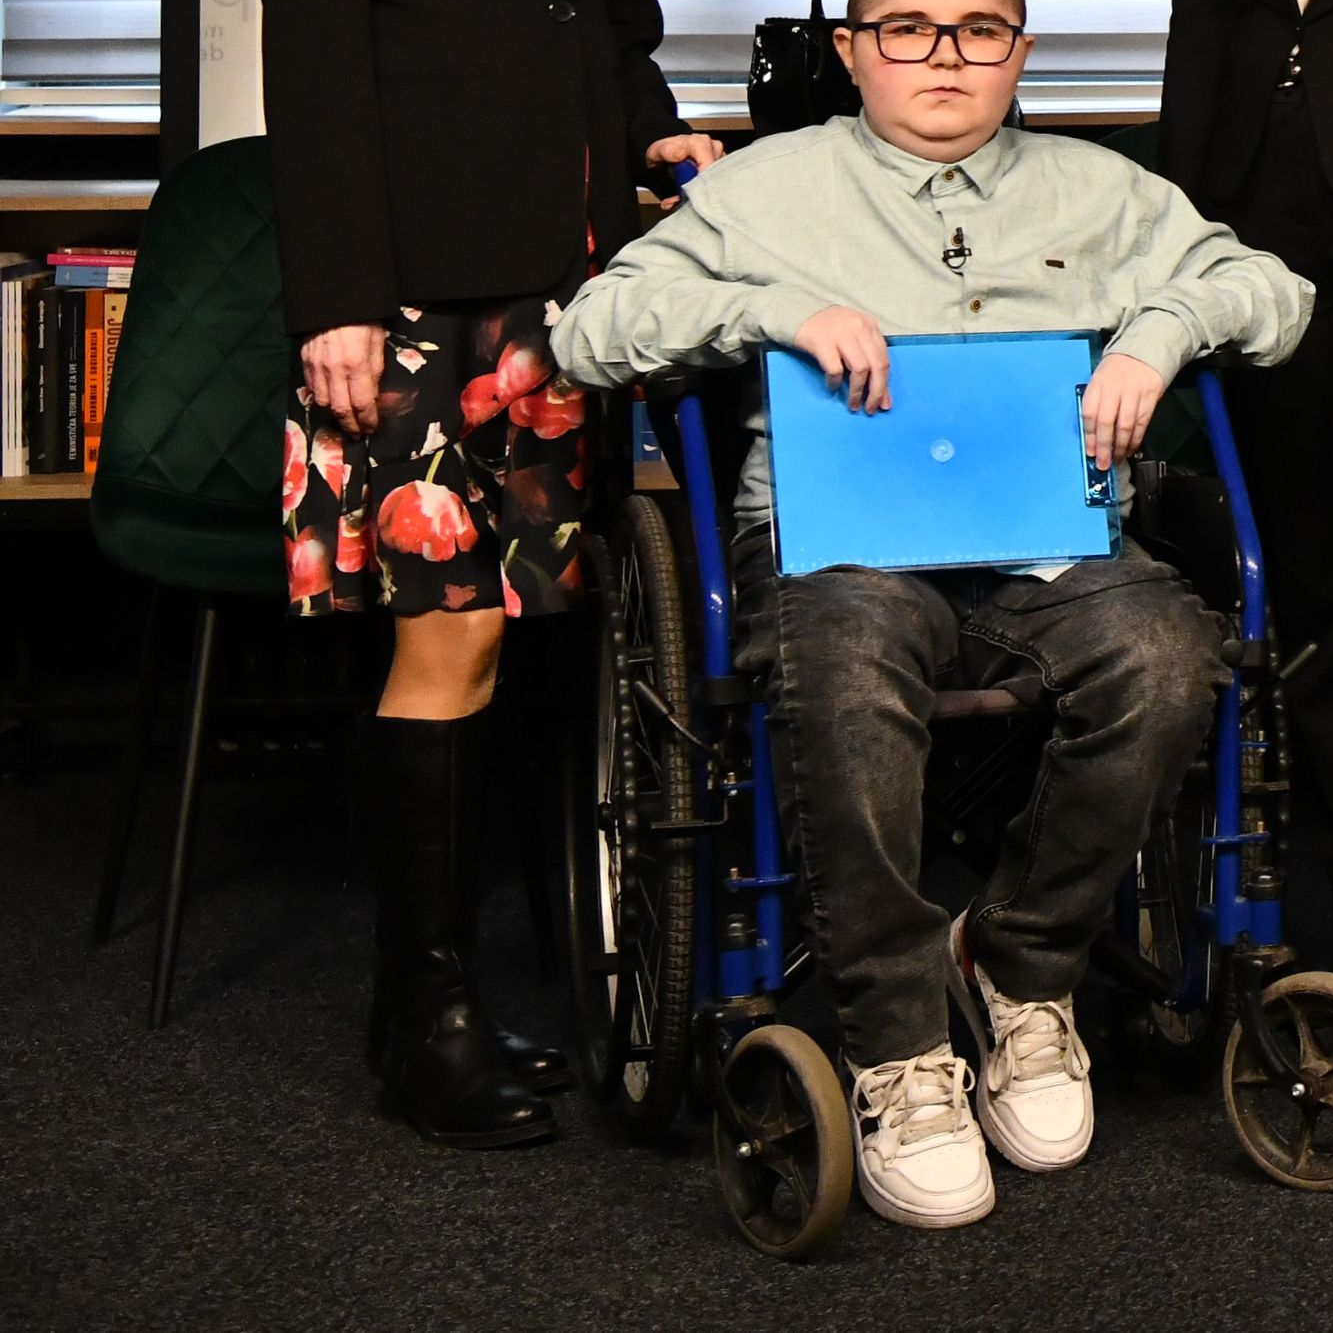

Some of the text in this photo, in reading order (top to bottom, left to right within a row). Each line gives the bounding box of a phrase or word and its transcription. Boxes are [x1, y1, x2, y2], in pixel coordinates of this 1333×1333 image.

[69, 362, 77, 374] SVE
[69, 375, 77, 384] ZA
[68, 392, 77, 417] TEORIJA
